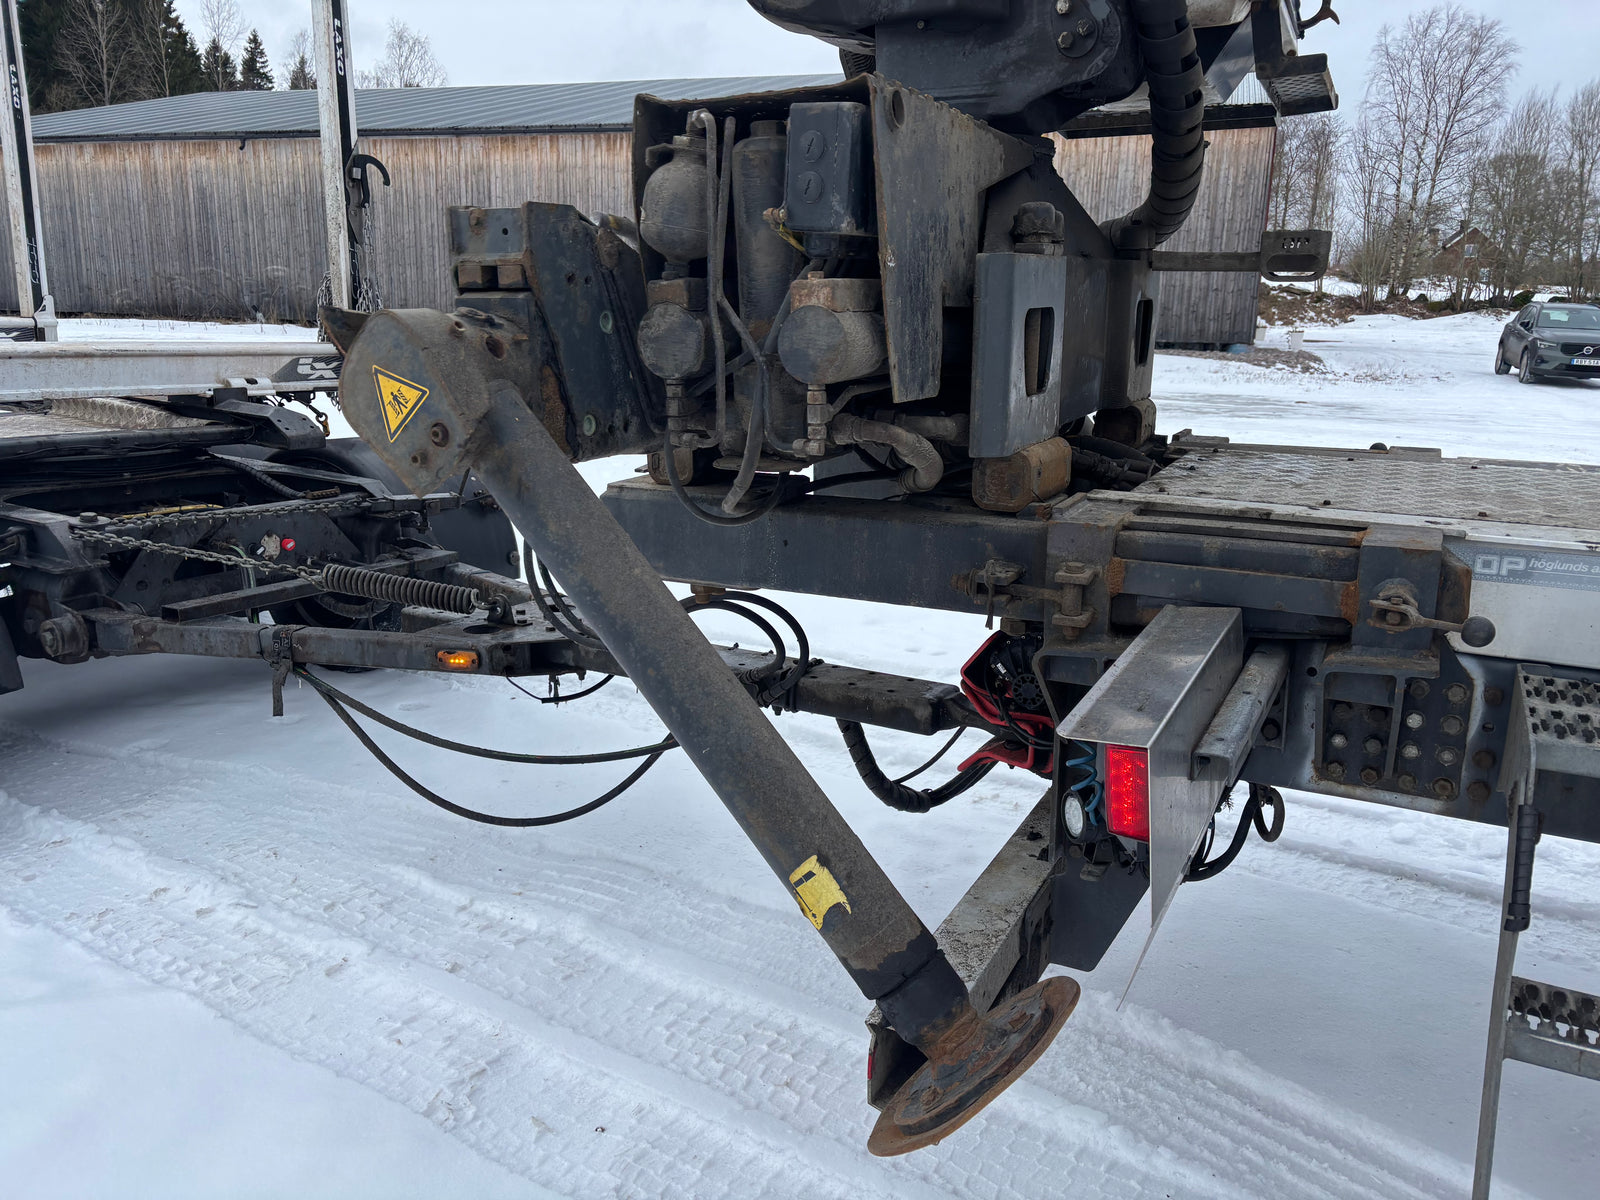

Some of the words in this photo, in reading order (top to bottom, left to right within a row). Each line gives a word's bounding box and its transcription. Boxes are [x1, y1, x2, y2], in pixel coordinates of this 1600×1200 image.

[334, 17, 344, 77] LAXO
[9, 64, 20, 109] LAXO
[1529, 558, 1588, 573] höglunds
[1590, 565, 1600, 574] a
